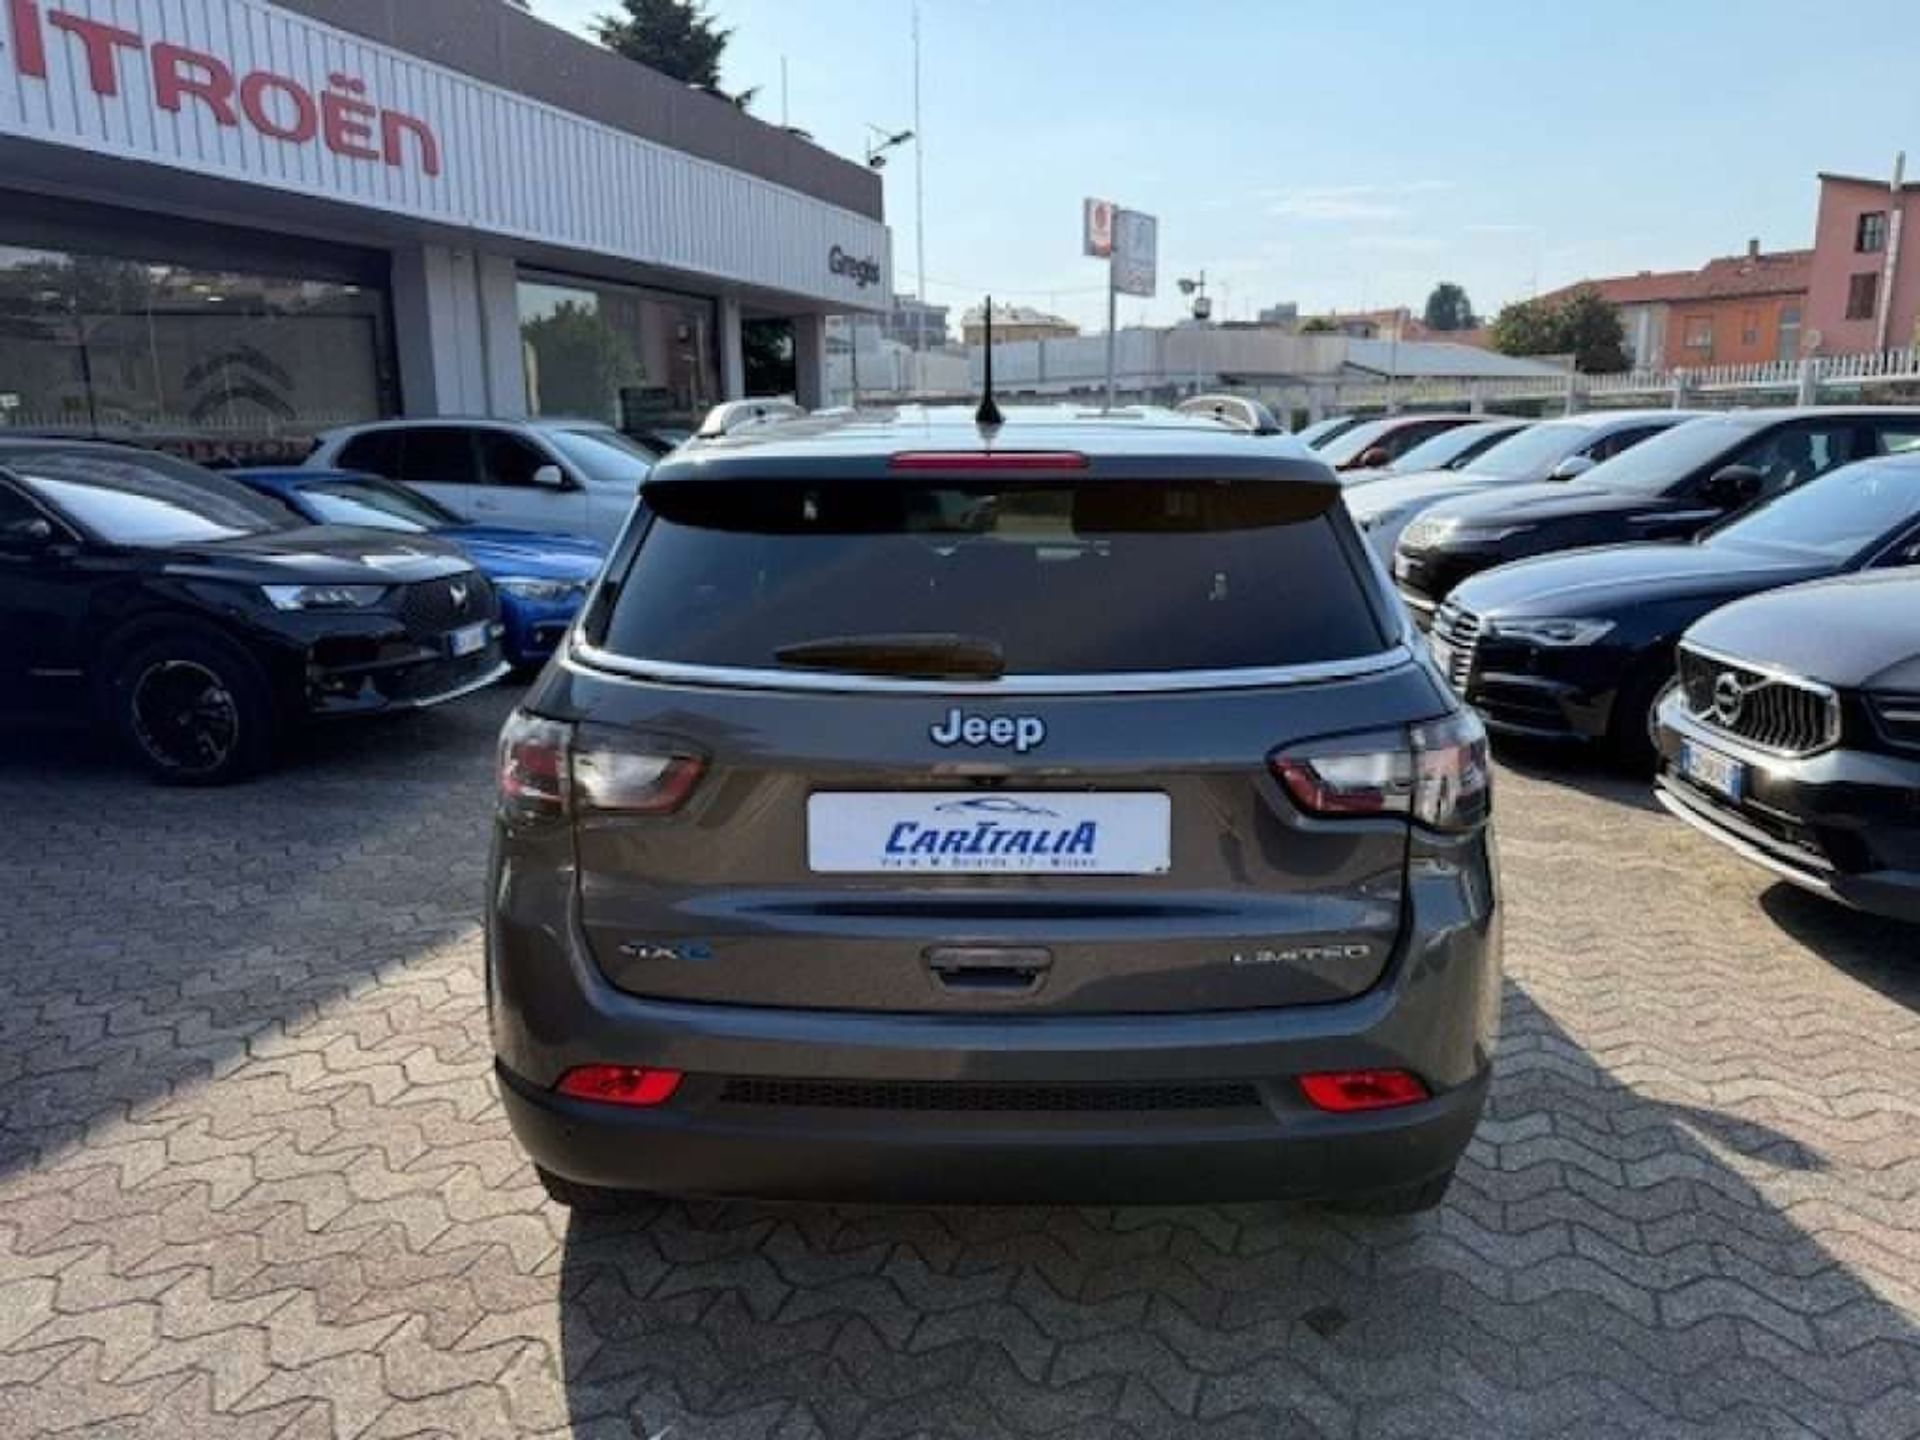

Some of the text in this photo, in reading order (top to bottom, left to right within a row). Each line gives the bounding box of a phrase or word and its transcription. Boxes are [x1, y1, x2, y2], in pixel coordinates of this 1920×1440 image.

[0, 0, 440, 176] ITROËN
[930, 708, 1045, 753] Jeep
[1231, 944, 1370, 963] LIMITED
